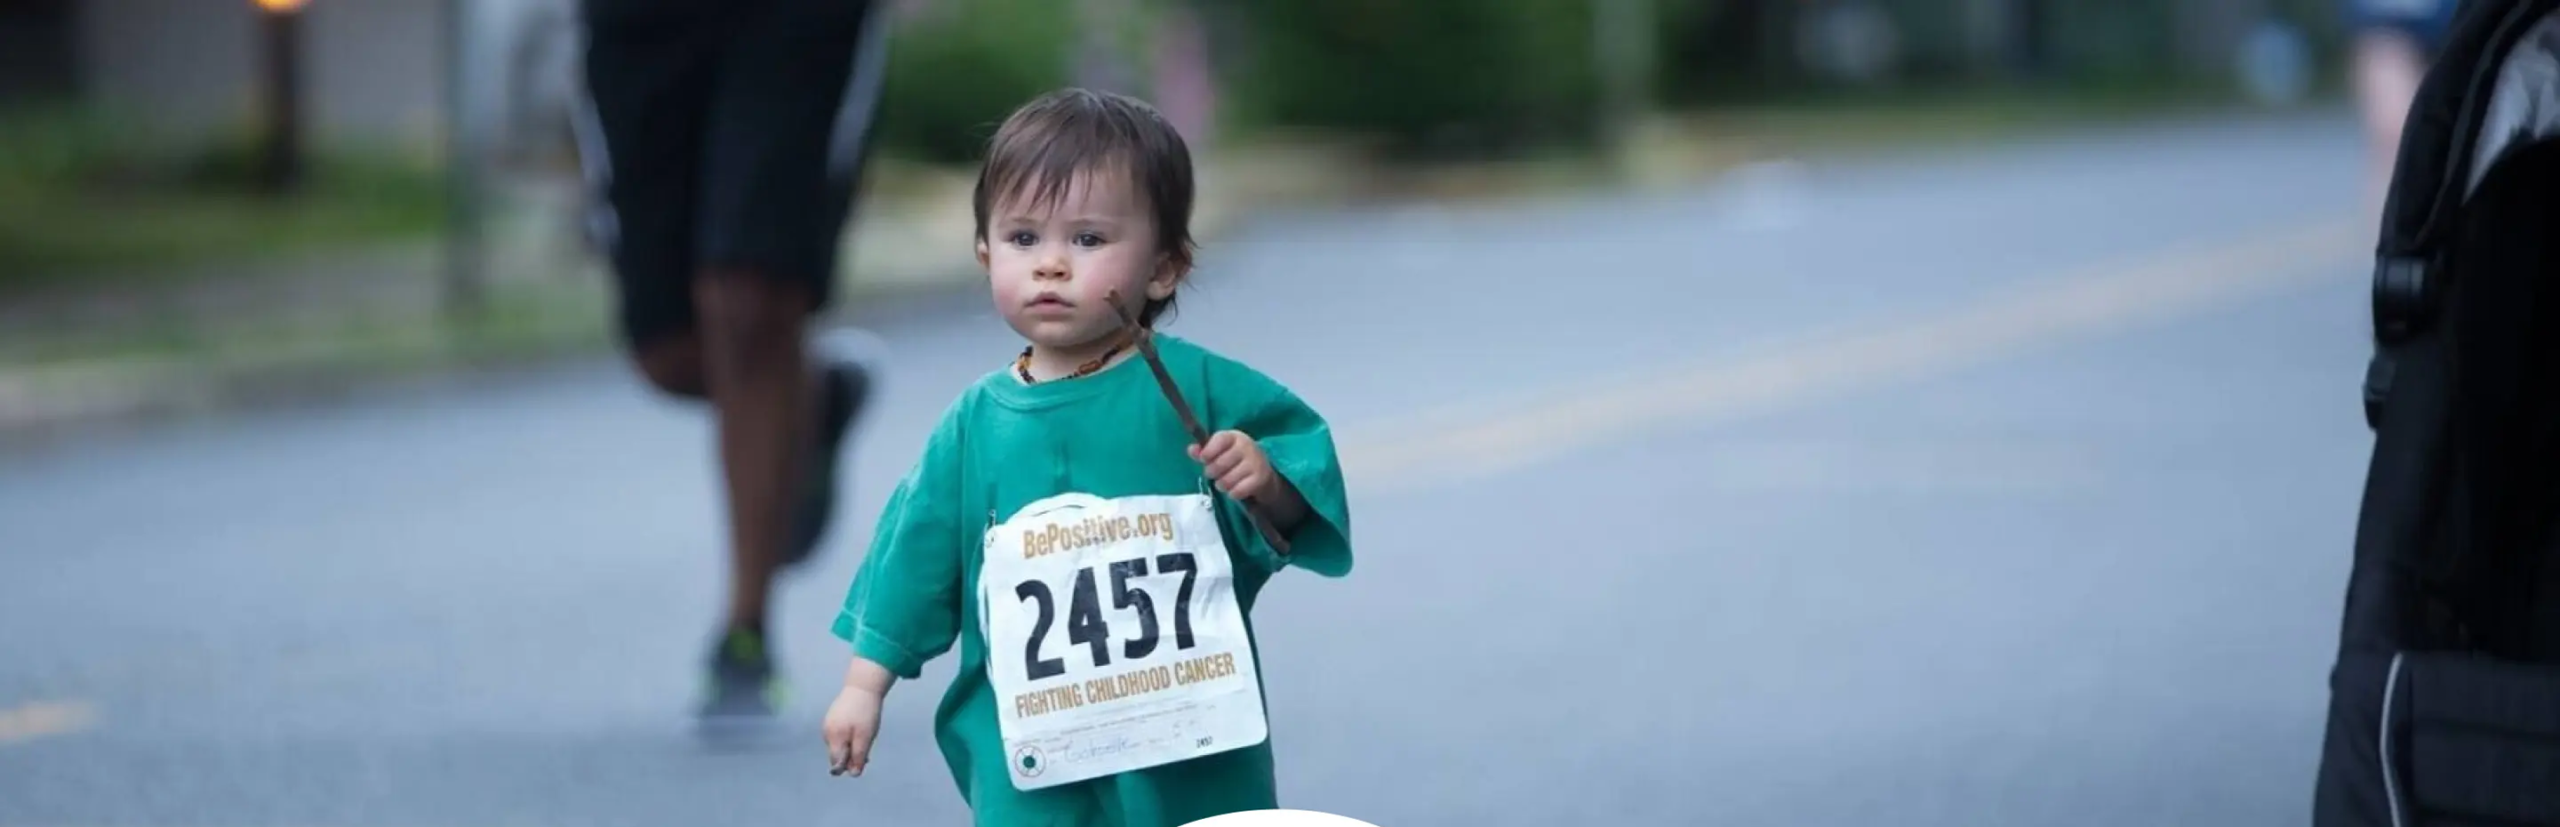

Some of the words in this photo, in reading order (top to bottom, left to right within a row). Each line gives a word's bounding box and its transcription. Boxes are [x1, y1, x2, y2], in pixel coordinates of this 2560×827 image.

[1023, 513, 1174, 558] BePositive.org
[1015, 552, 1197, 680] 2457
[1015, 685, 1084, 718] FIGHTING
[1085, 666, 1171, 705] CHILDHOOD
[1174, 652, 1236, 686] CANCER
